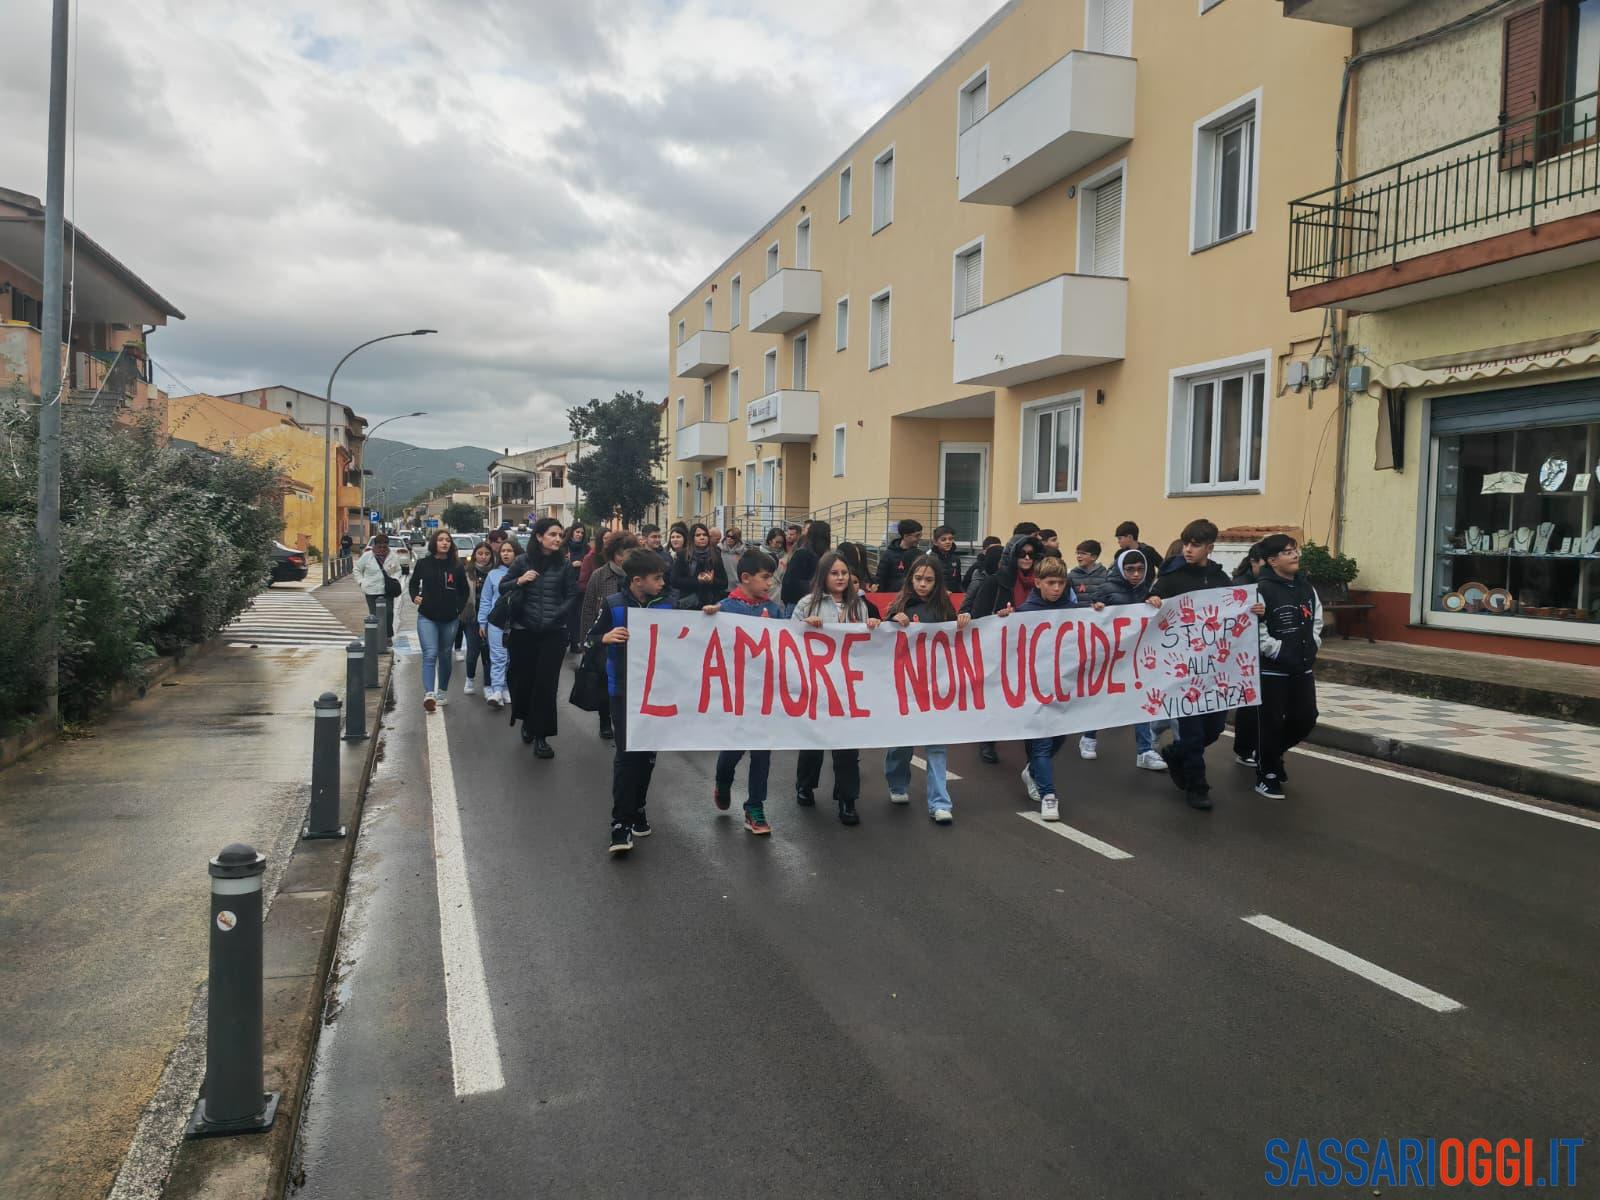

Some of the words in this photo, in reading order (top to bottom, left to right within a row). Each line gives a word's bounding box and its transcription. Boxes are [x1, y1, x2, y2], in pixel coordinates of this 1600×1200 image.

[1161, 617, 1237, 649] STOP
[640, 624, 871, 720] L'AMORE
[894, 627, 986, 716] NON
[1000, 617, 1149, 709] UCCIDE!
[1188, 655, 1216, 675] ALLA
[1162, 685, 1248, 718] VIOLENZA
